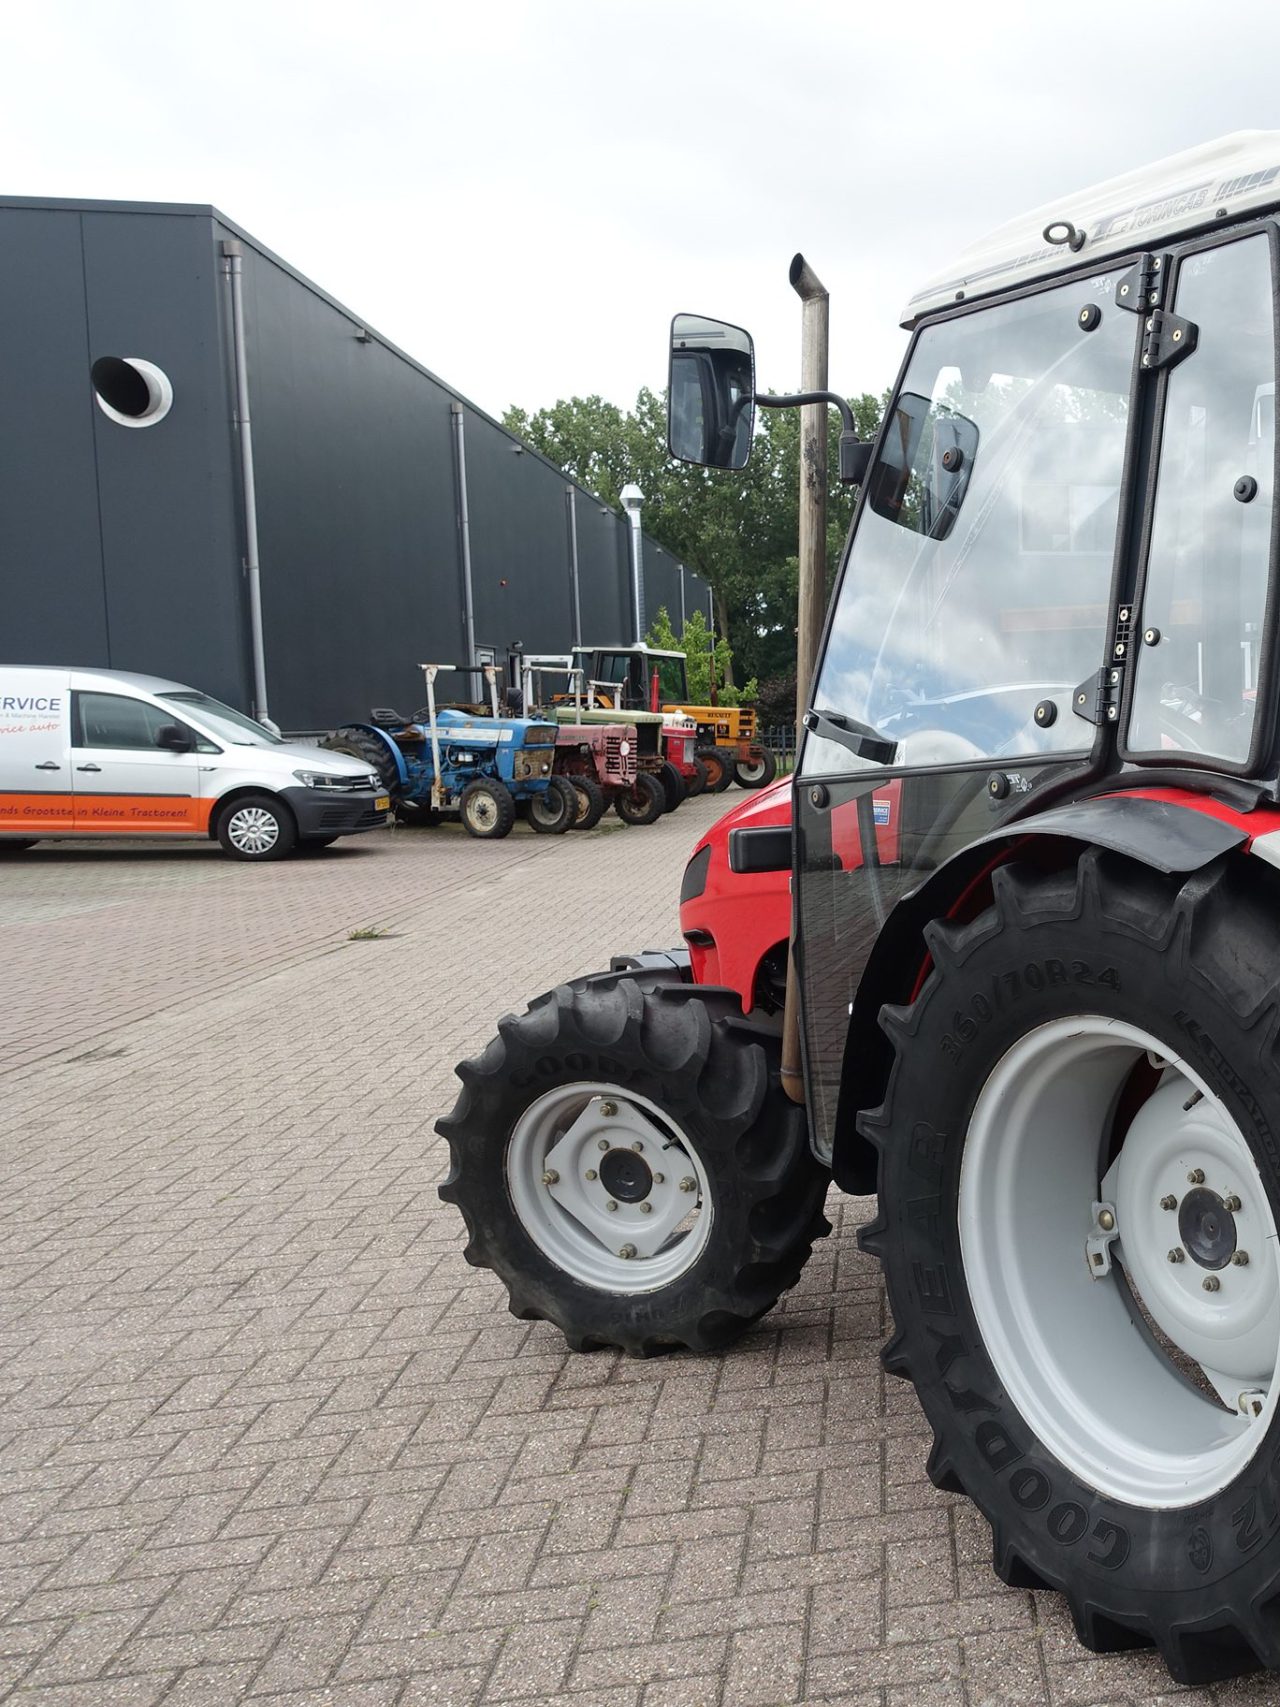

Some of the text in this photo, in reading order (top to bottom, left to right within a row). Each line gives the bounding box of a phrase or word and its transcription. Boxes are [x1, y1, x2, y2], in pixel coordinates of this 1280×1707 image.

[0, 697, 61, 711] RVICE
[23, 806, 73, 816] Grootste
[92, 807, 125, 816] Kleine
[906, 1120, 1131, 1572] GOODYEAR
